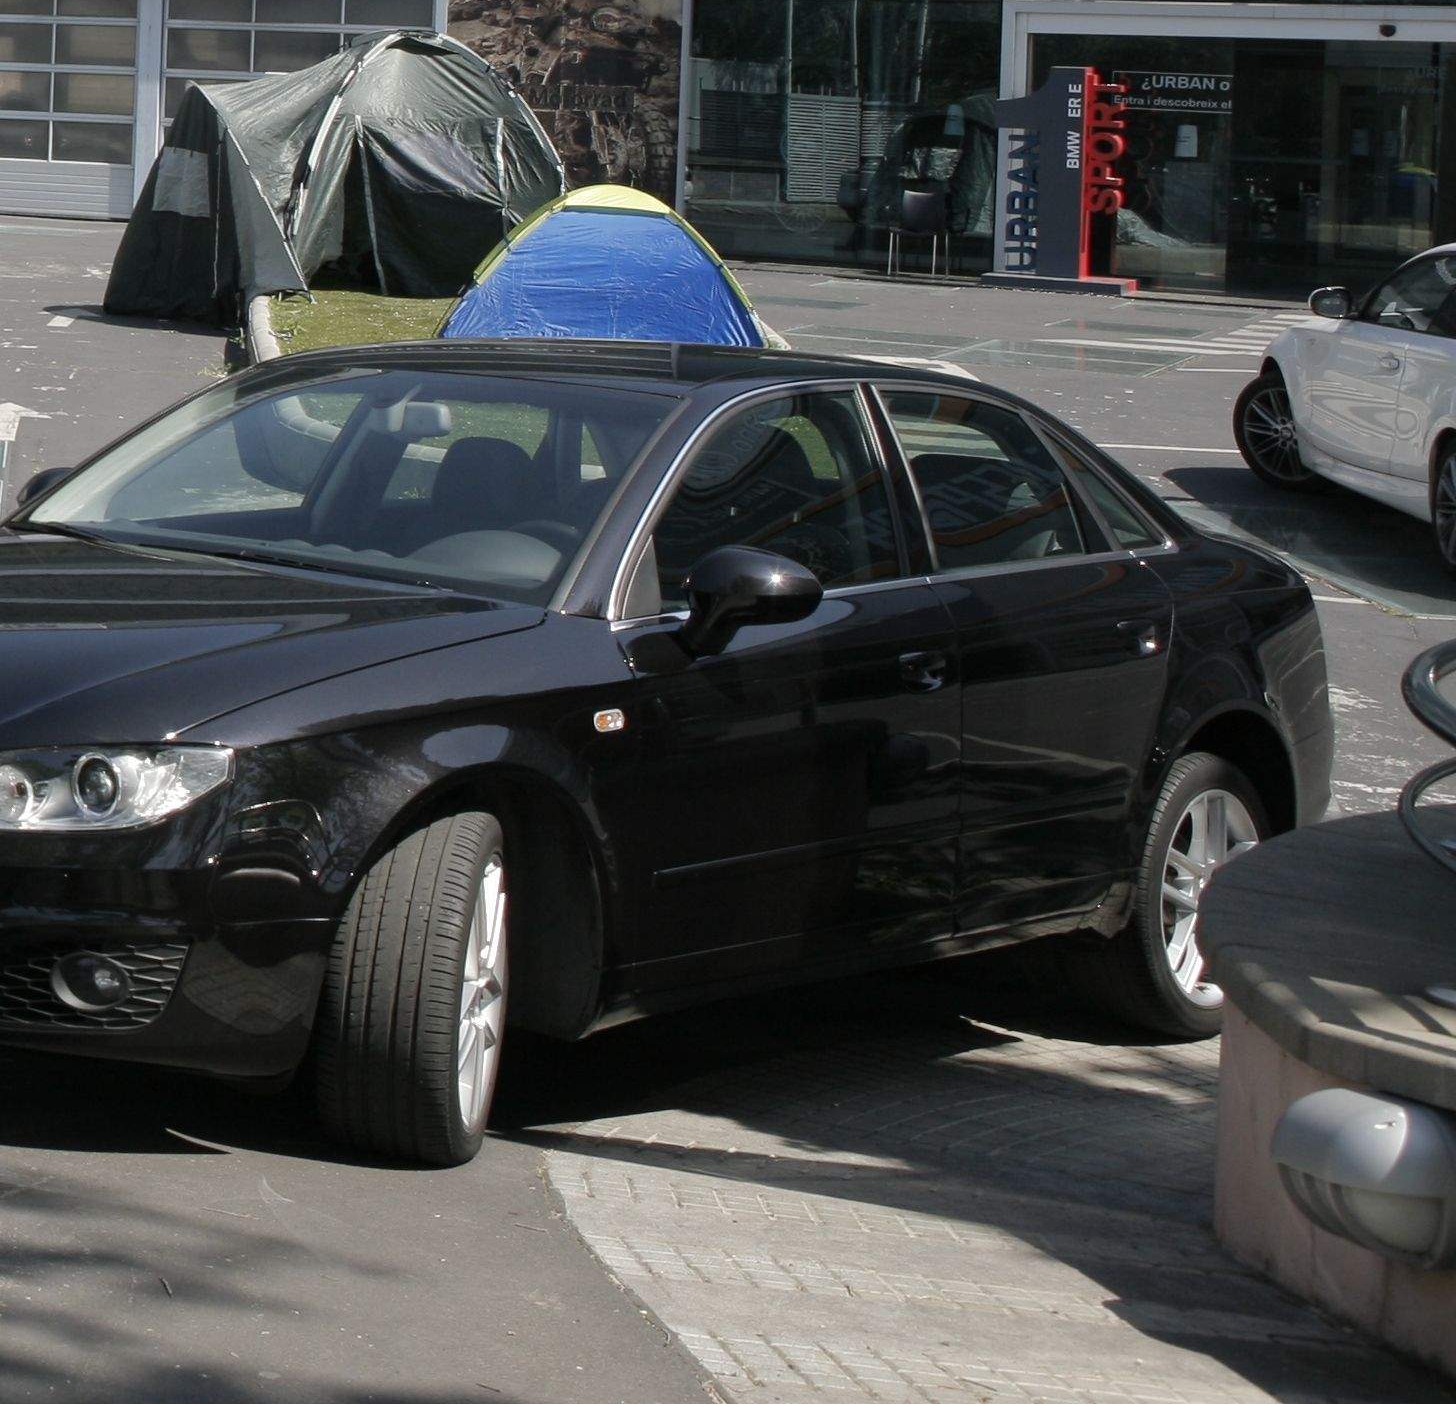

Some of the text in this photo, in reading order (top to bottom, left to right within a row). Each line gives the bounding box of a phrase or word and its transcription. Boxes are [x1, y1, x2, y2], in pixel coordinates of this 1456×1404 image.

[1141, 75, 1215, 91] ¿URBAN
[1153, 96, 1218, 109] descobreix
[1066, 130, 1080, 169] BMW
